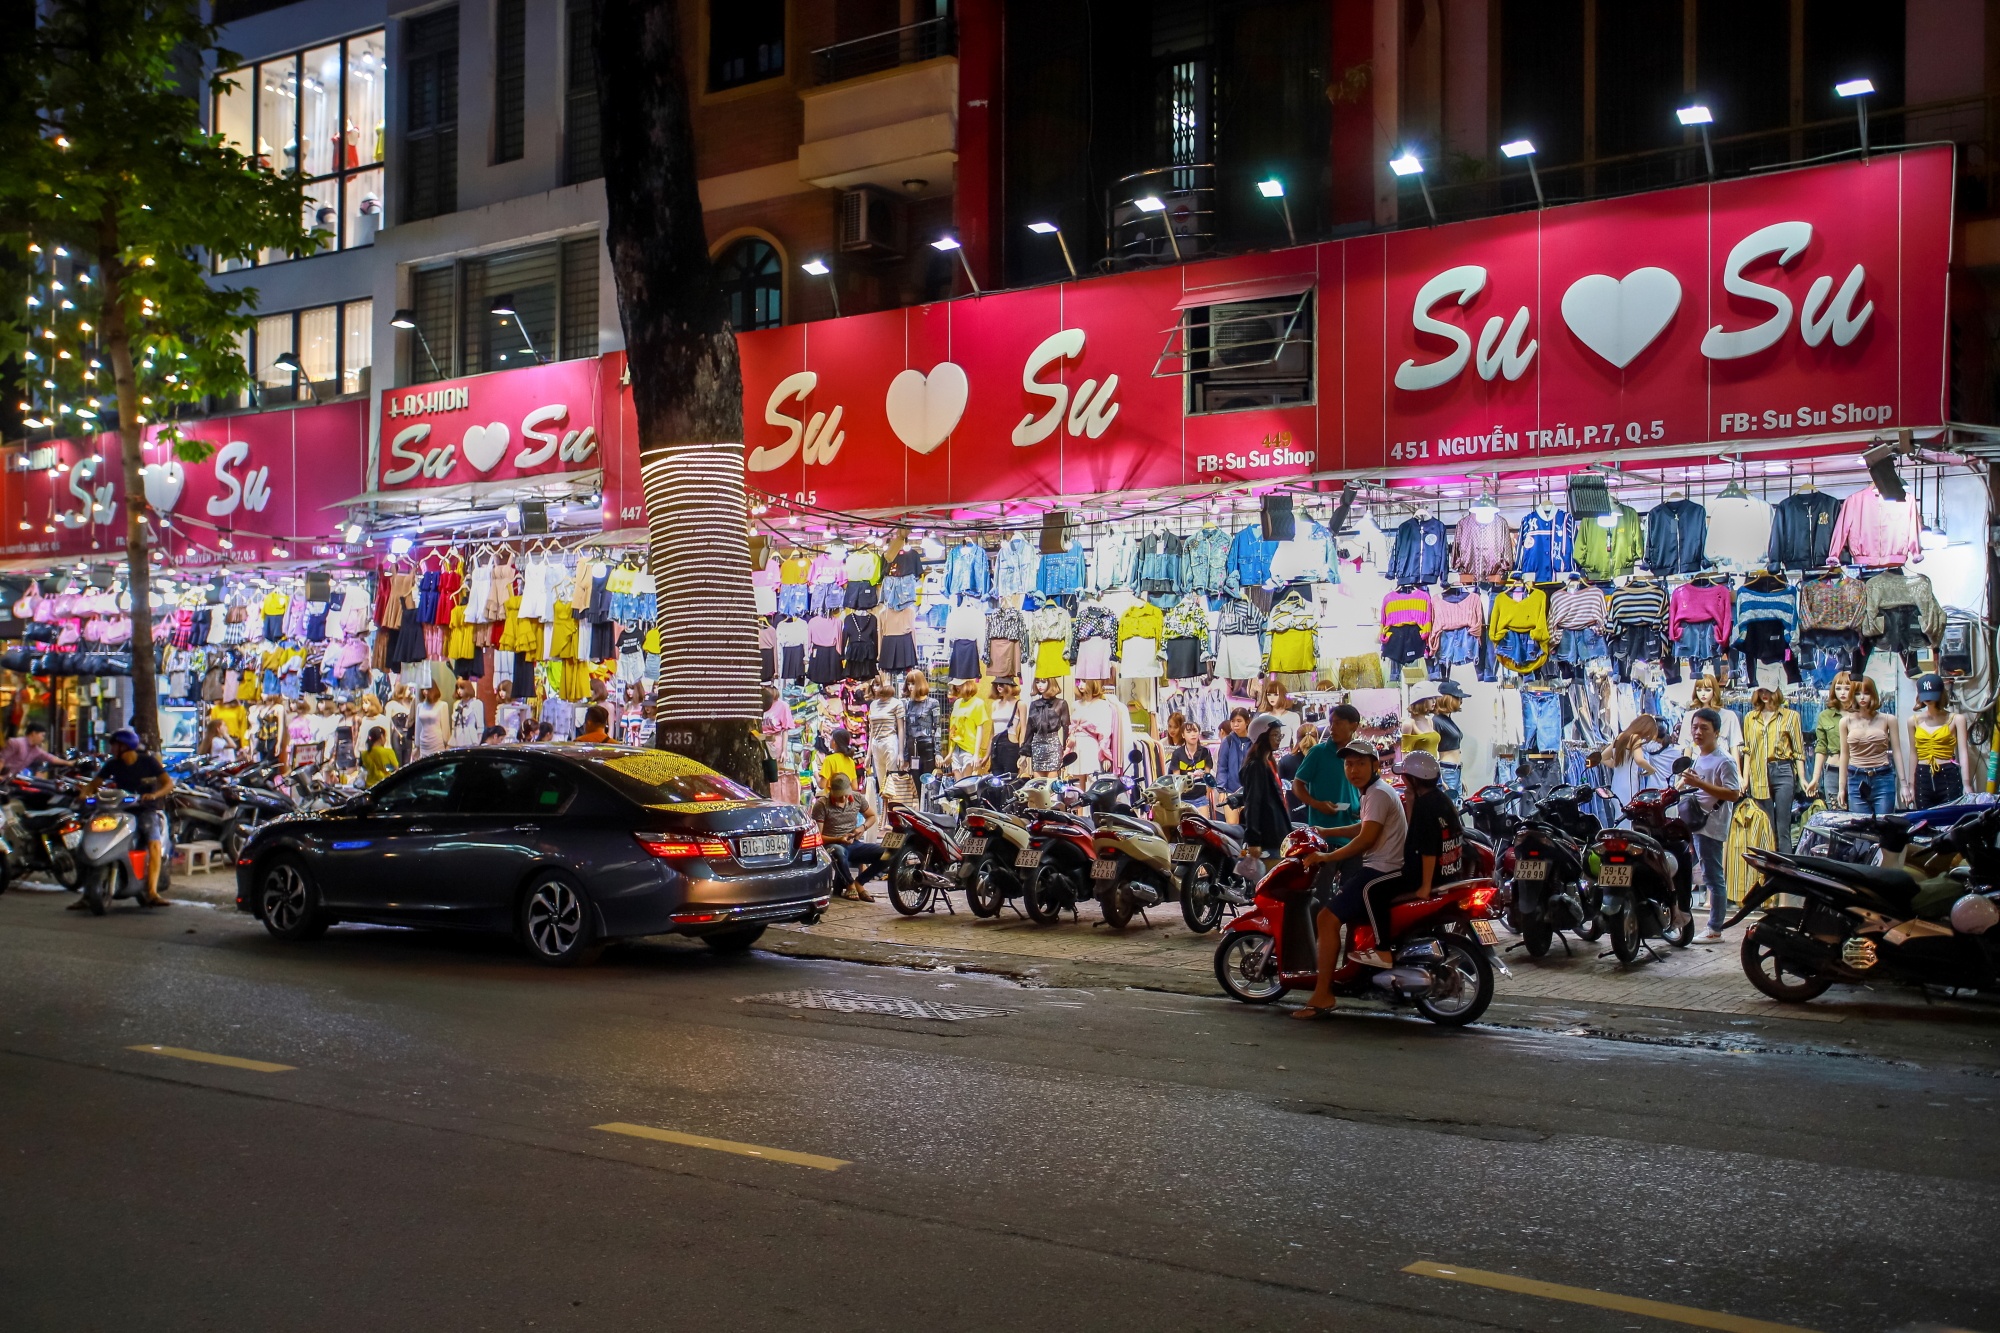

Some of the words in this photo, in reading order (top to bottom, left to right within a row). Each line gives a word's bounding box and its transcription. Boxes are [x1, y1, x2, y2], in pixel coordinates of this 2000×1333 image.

[1394, 265, 1538, 390] Su
[1700, 221, 1875, 360] Su
[388, 386, 469, 418] FASHION
[748, 371, 845, 472] Su
[1011, 328, 1120, 447] Su
[1720, 413, 1757, 433] FB:
[1762, 410, 1792, 430] Su
[1796, 406, 1827, 427] Su
[1831, 403, 1892, 424] Shop
[383, 423, 457, 485] Su
[514, 404, 597, 468] Su
[1262, 431, 1292, 448] 449
[1390, 441, 1430, 460] 451
[1438, 425, 1518, 457] NGUYỄN
[1626, 420, 1665, 443] Q.5
[1197, 455, 1223, 473] FB:
[1225, 452, 1246, 470] Su
[1249, 450, 1270, 468] Su
[1272, 447, 1316, 467] Shop
[63, 458, 117, 529] Su
[206, 441, 271, 516] Su
[621, 506, 642, 521] 447
[665, 732, 692, 745] 335
[1604, 866, 1628, 876] 59-K2
